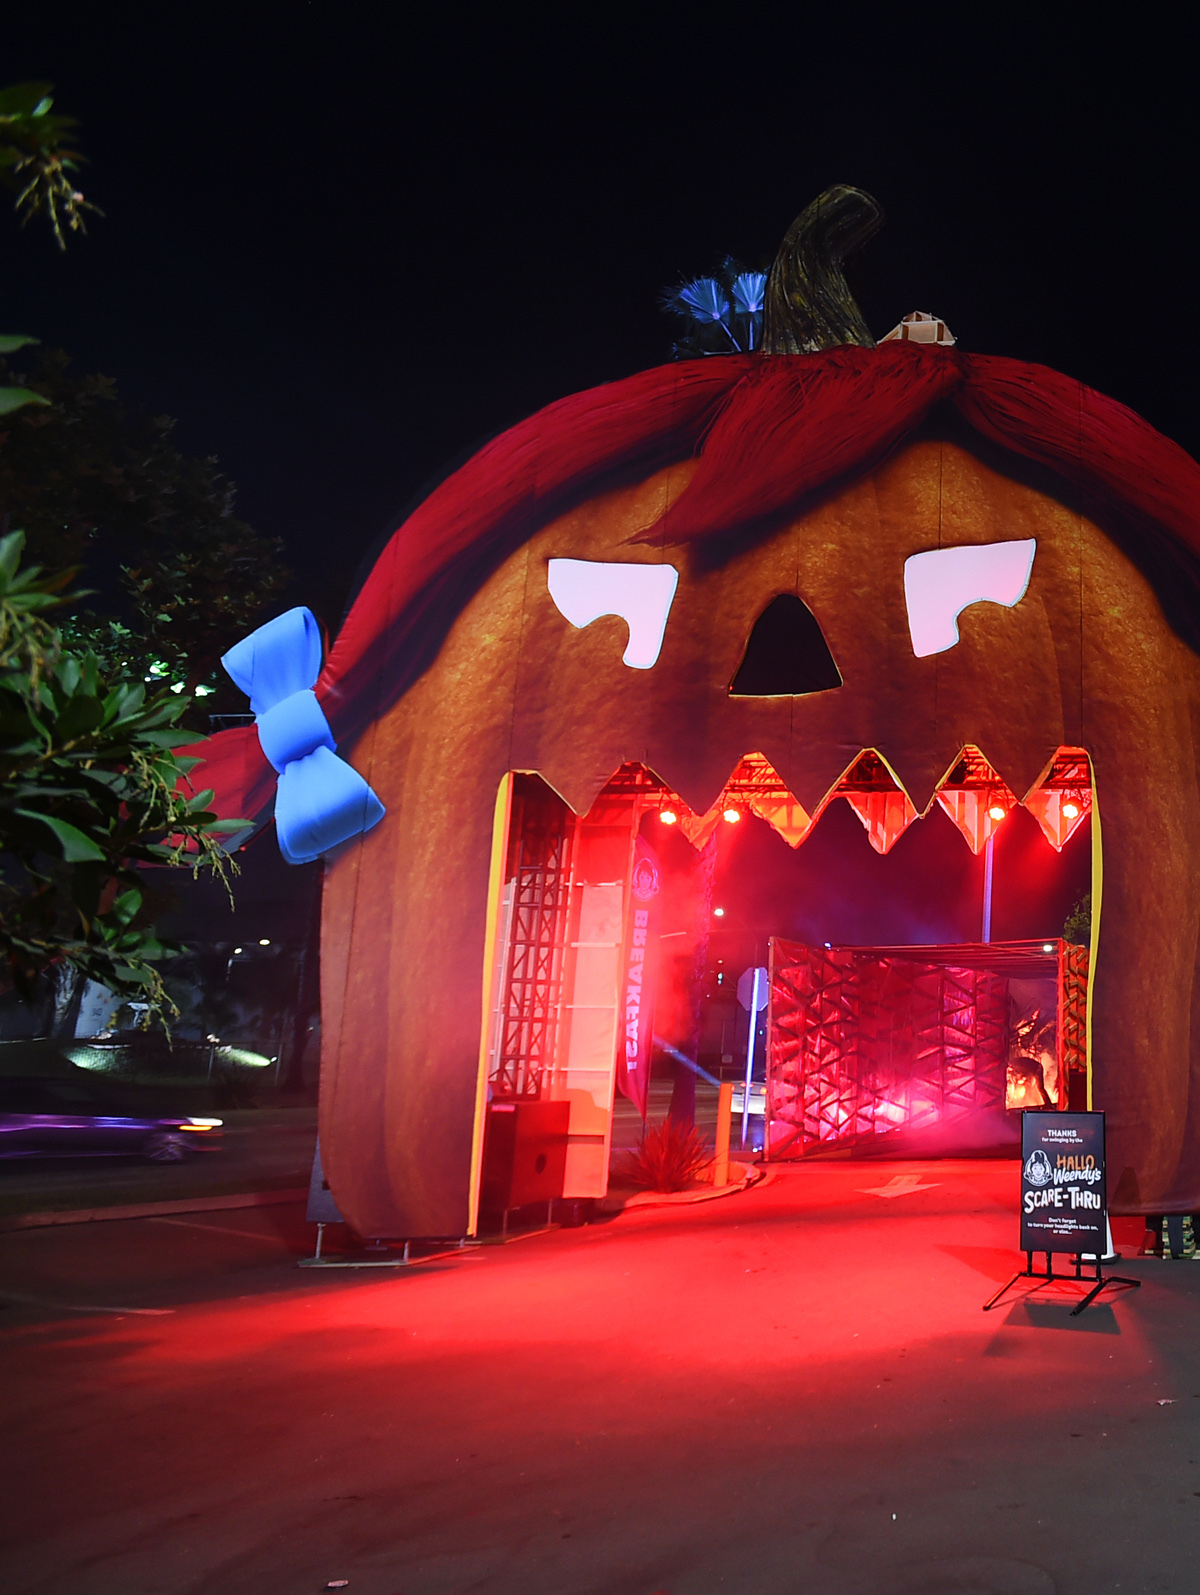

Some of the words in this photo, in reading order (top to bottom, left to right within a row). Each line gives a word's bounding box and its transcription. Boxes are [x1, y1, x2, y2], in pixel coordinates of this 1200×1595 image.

[1047, 1129, 1077, 1137] THANKS
[1056, 1154, 1095, 1171] HALLO
[1053, 1164, 1102, 1186] Weendy's
[1024, 1186, 1101, 1214] SCARE-THRU
